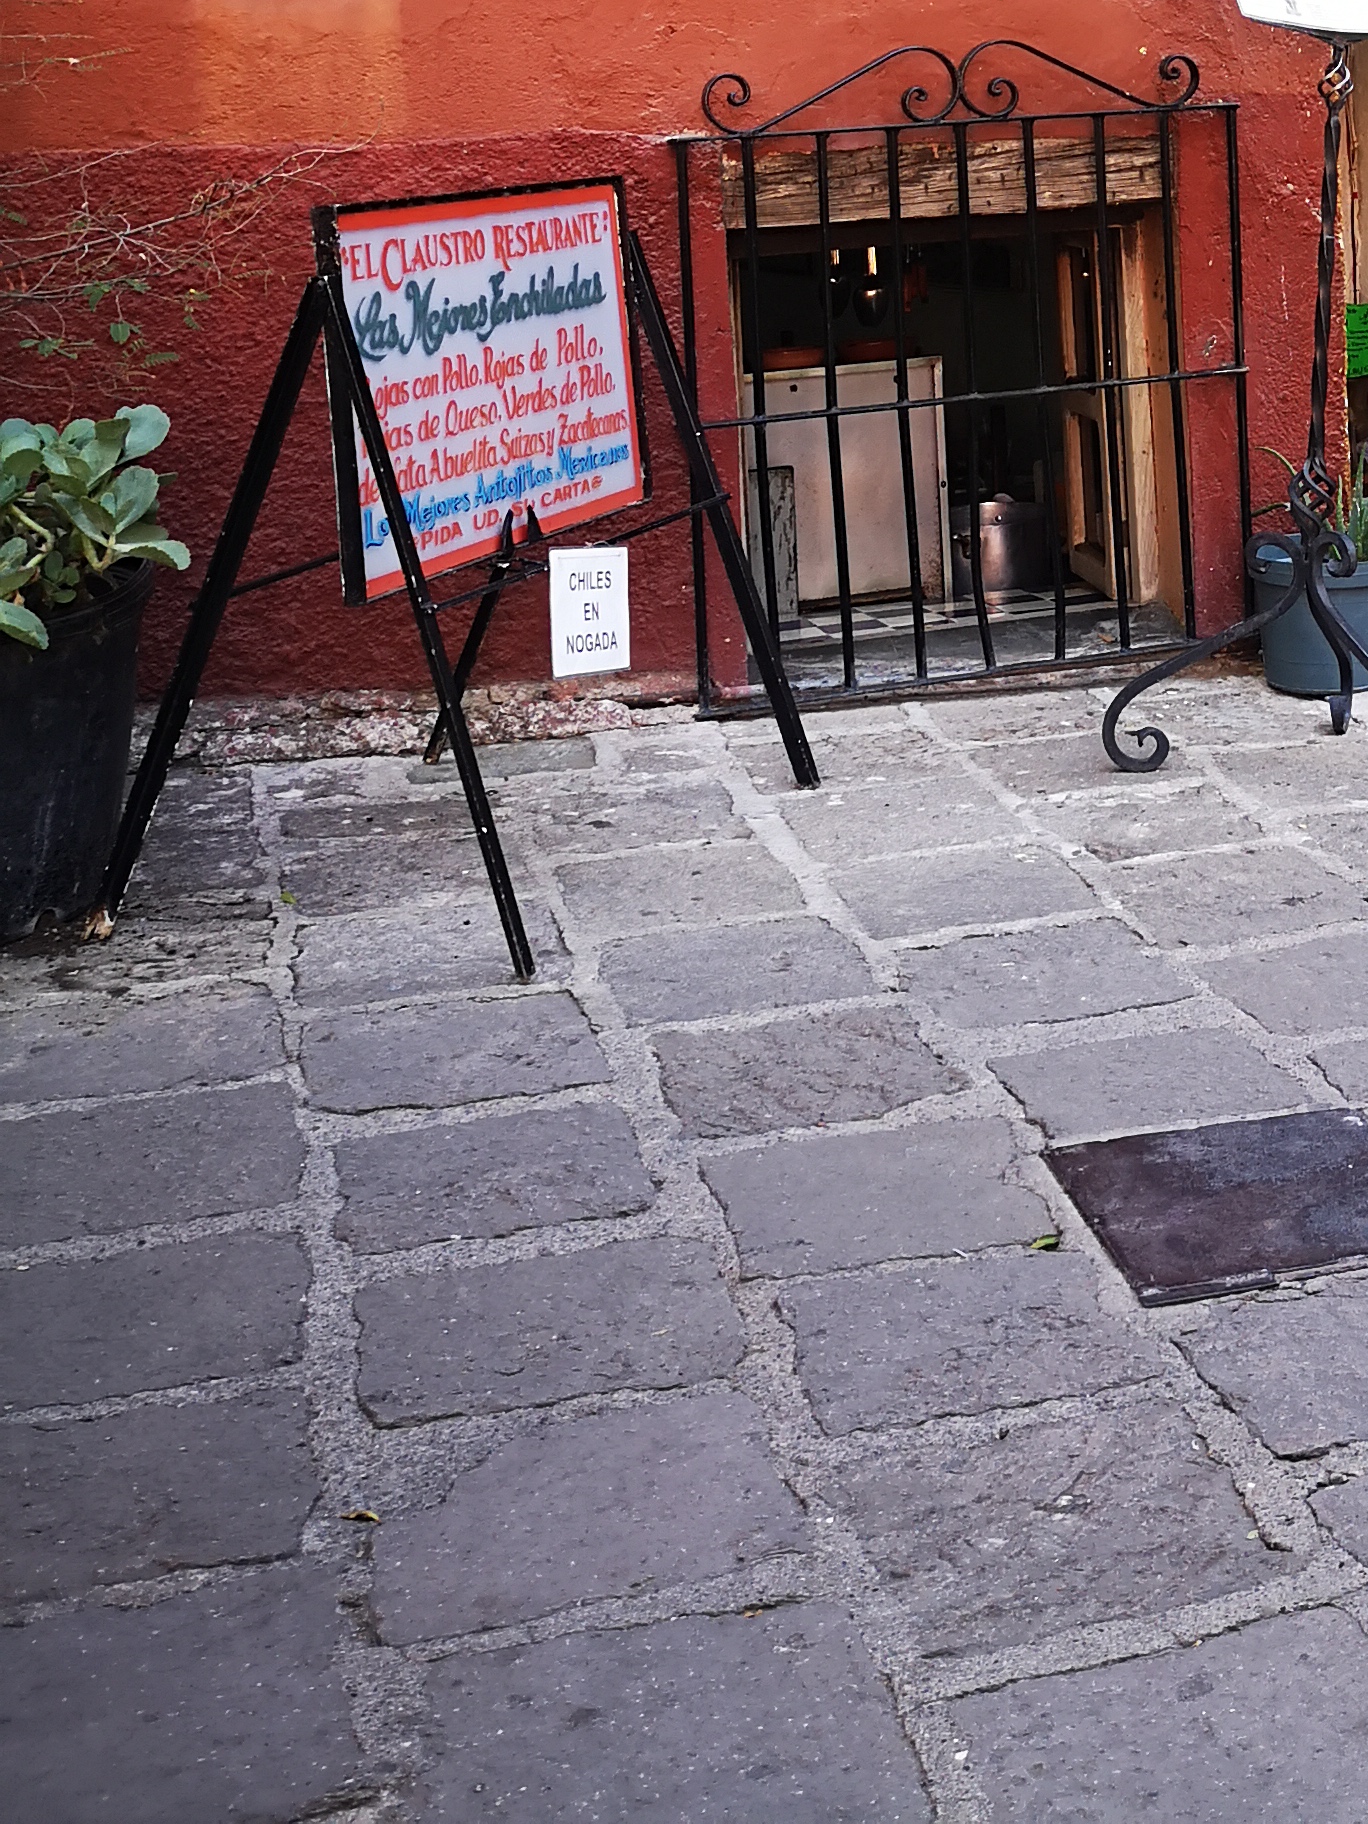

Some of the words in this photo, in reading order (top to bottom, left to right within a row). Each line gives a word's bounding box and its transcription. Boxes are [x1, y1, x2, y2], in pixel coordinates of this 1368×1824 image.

[381, 229, 486, 291] CLAUSTRO
[354, 290, 400, 362] Las
[400, 277, 488, 356] Mejores
[477, 262, 607, 342] Enchiladas
[366, 375, 410, 420] ojas
[413, 373, 440, 401] con
[483, 345, 525, 389] Rojas
[530, 337, 547, 373] de
[417, 409, 441, 443] de
[502, 377, 557, 420] Verdes
[560, 370, 578, 406] de
[429, 434, 498, 485] Abuelita
[500, 427, 546, 466] Suizas
[546, 426, 556, 458] y
[363, 507, 390, 549] Lo
[402, 489, 471, 534] Mejores
[474, 459, 554, 509] Antojitos
[555, 443, 630, 482] Mexicanos
[421, 521, 464, 552] PIDA
[540, 478, 591, 508] CARTA
[569, 570, 612, 591] CHILES
[583, 601, 600, 622] EN
[566, 630, 619, 655] NOGADA
